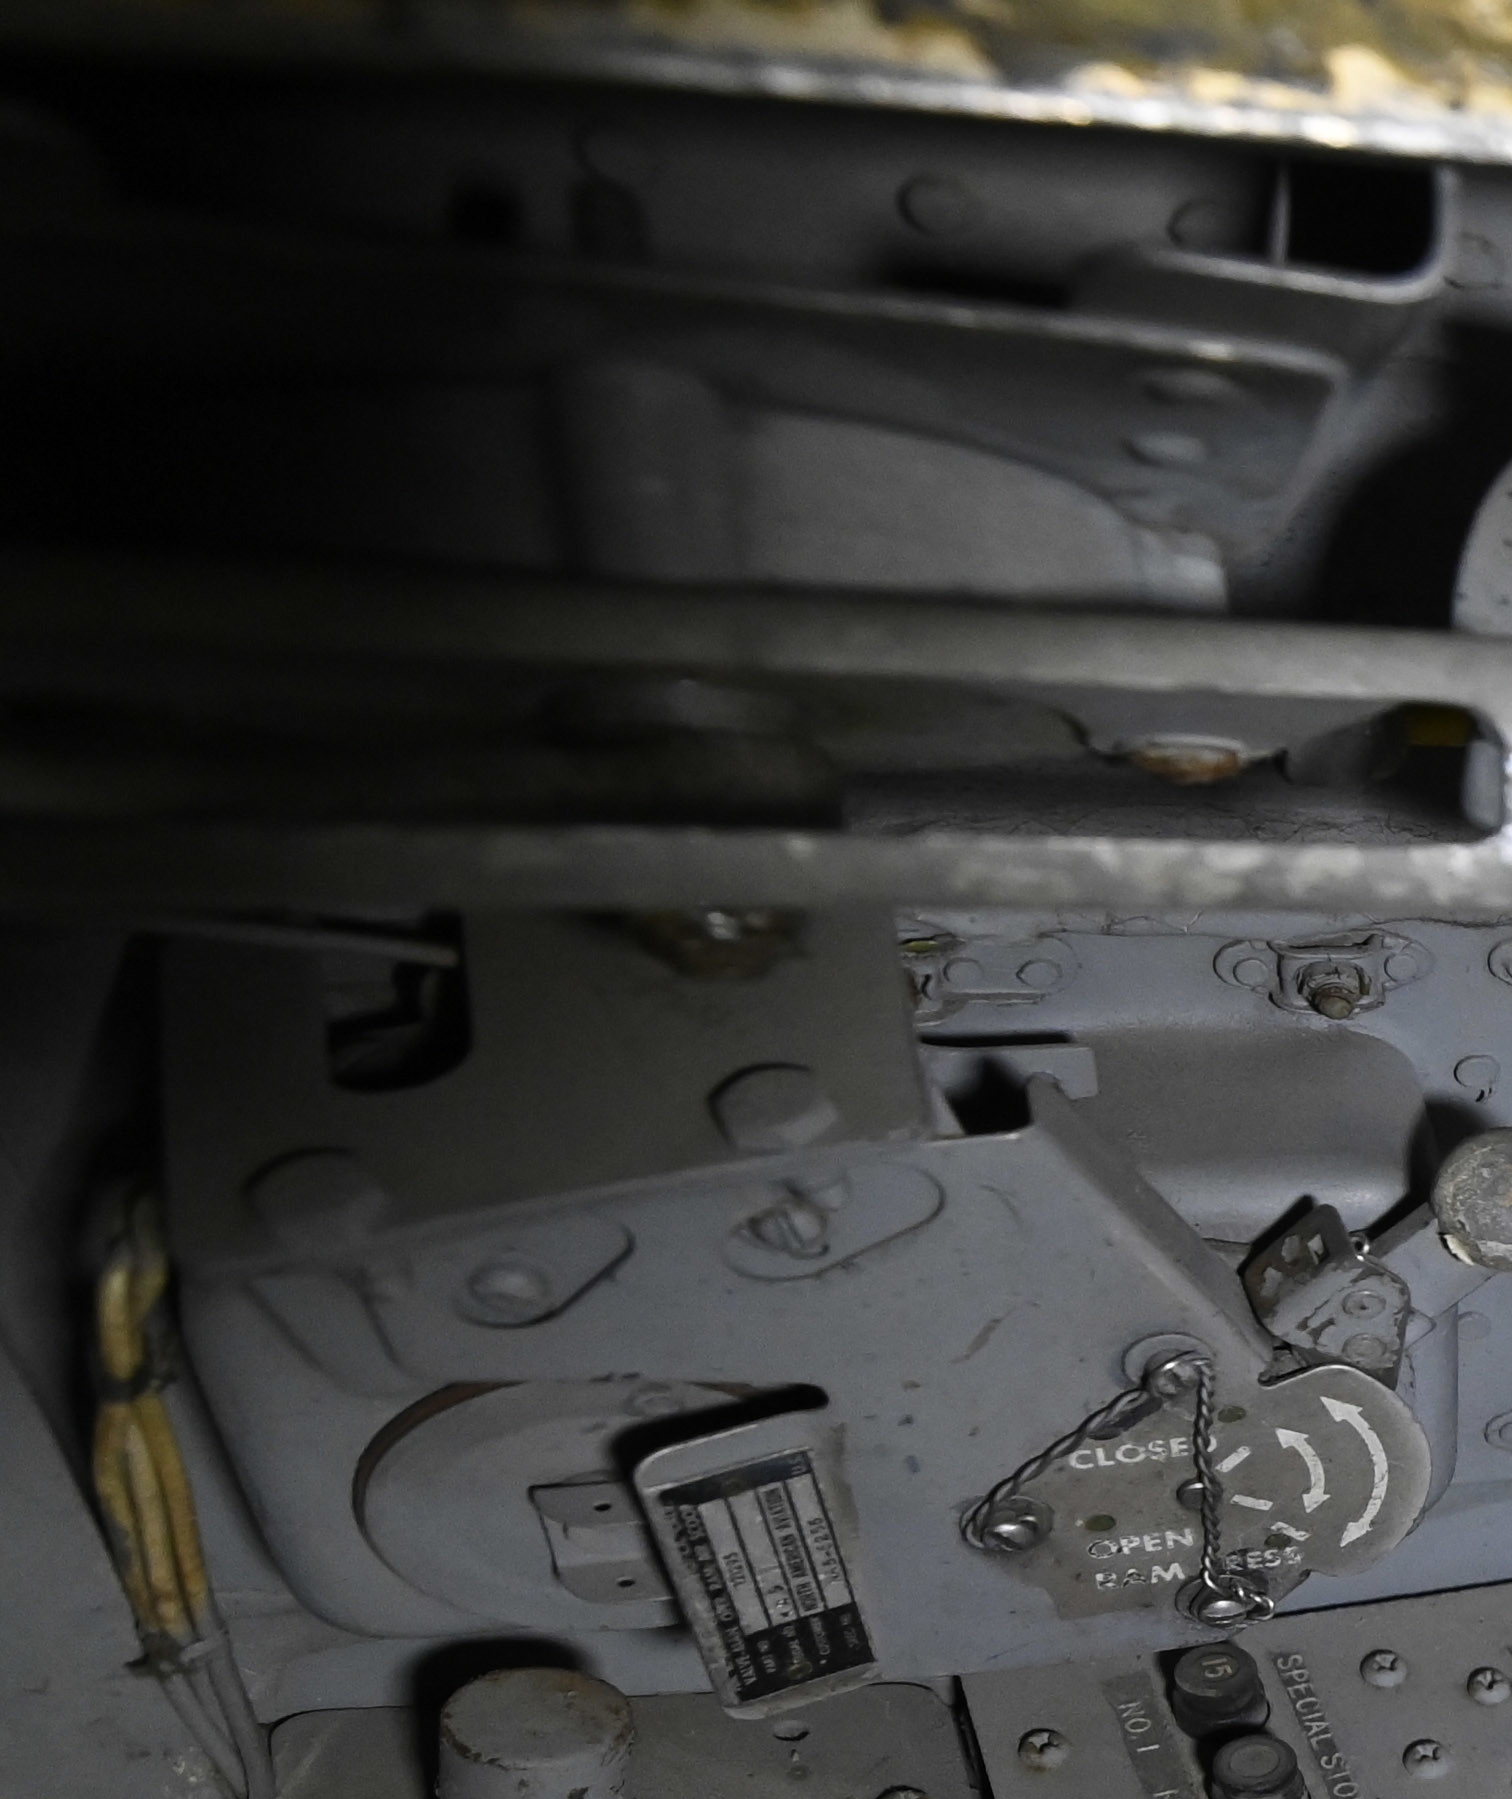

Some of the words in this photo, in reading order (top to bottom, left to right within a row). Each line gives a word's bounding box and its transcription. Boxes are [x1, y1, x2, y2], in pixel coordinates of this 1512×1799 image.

[1086, 1527, 1196, 1560] OPEN
[1205, 1656, 1231, 1679] 15
[1274, 1651, 1323, 1750] SPECIAL
